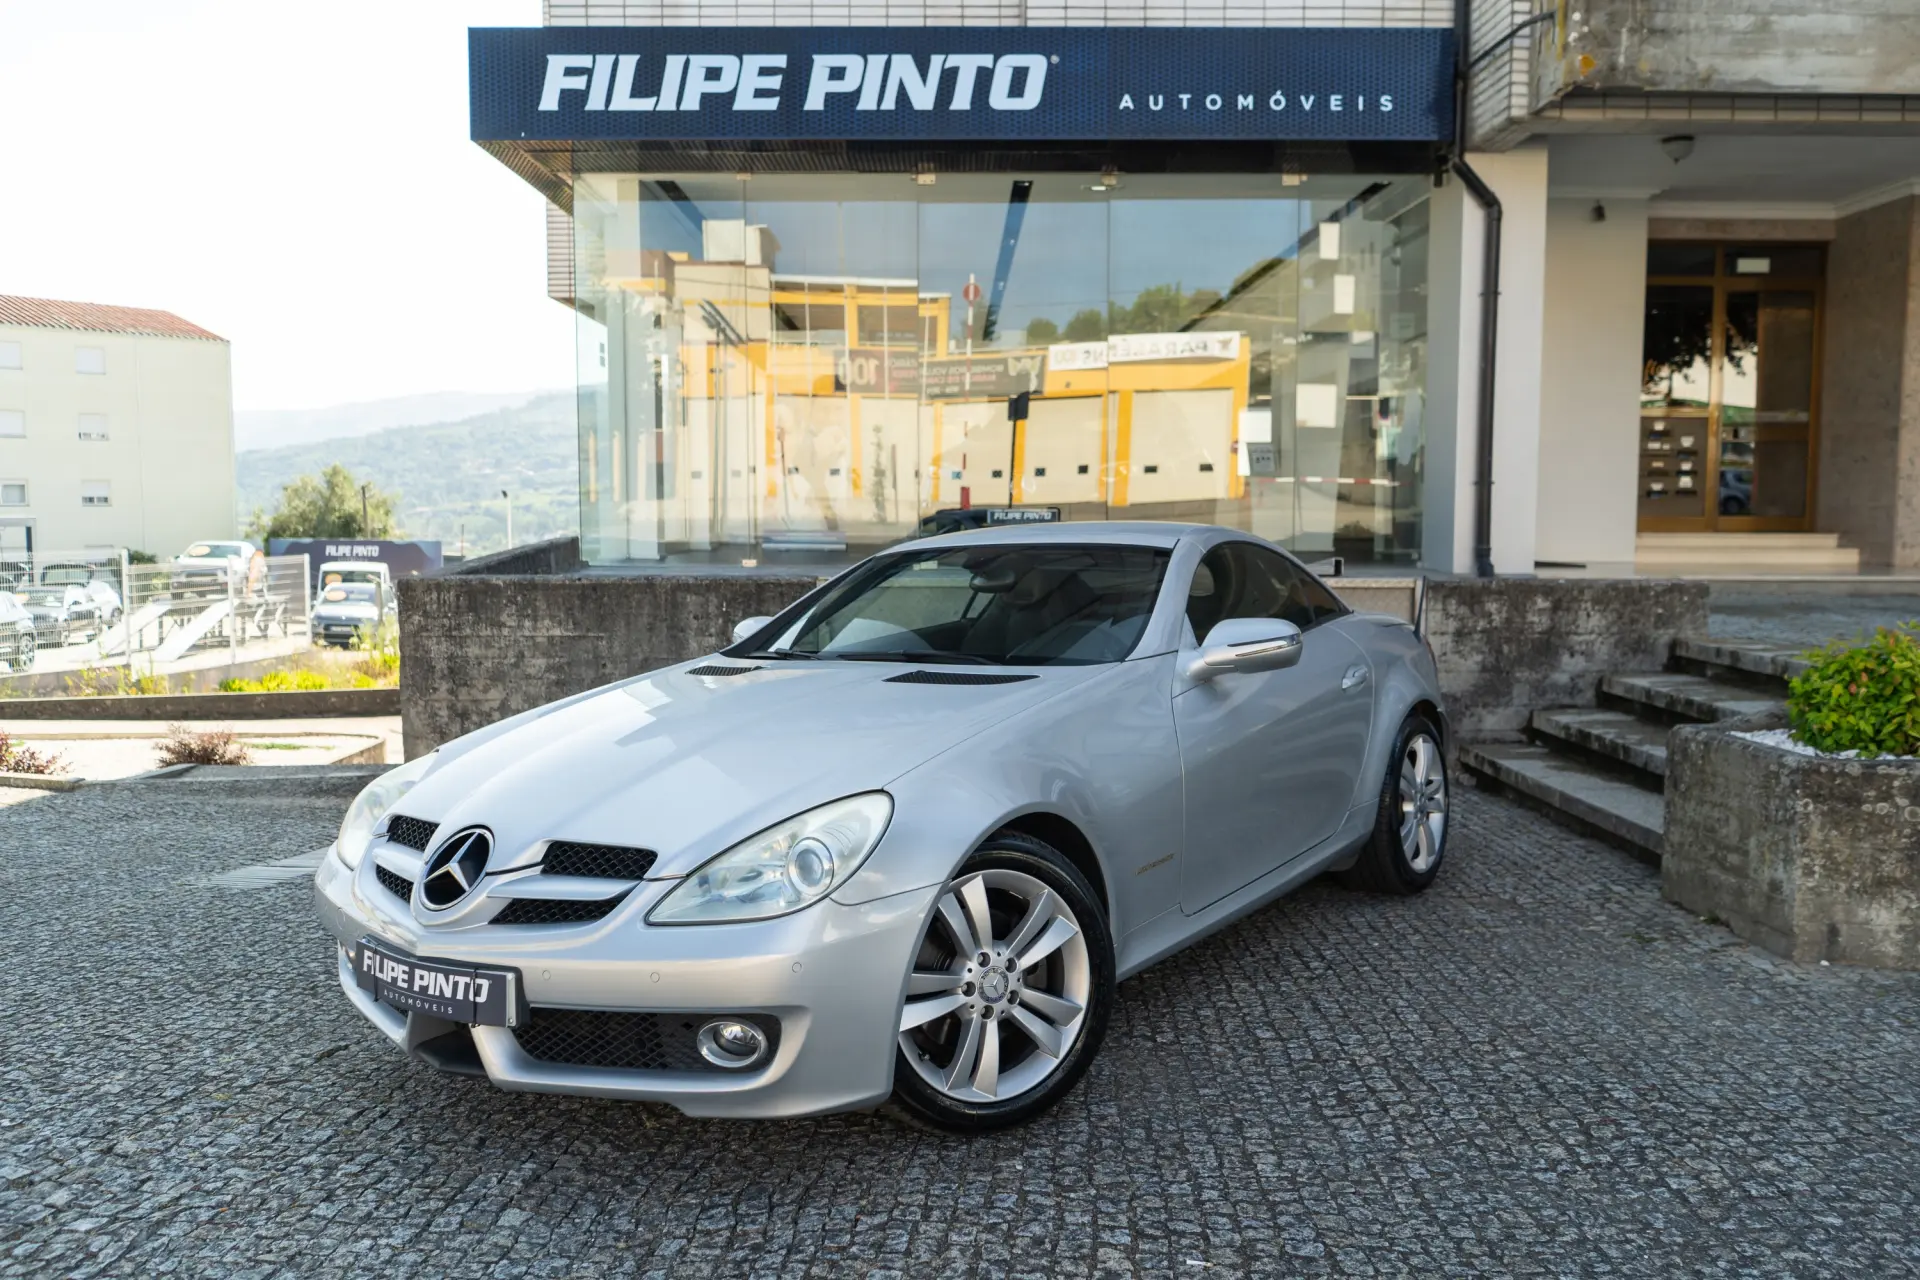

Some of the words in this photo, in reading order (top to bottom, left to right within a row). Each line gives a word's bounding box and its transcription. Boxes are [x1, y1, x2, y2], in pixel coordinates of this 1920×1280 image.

[538, 54, 788, 111] FILIPE
[803, 54, 1049, 111] PINTO
[1119, 90, 1394, 112] AUTOMÓVEIS
[994, 511, 1022, 520] FILIPE
[1023, 511, 1053, 520] PINTO
[325, 545, 351, 557] FILIPE
[352, 545, 380, 557] PINTO
[363, 949, 409, 989] FILIPE
[413, 968, 490, 1003] PINTO
[383, 988, 453, 1014] AUTOMÓVEIS
